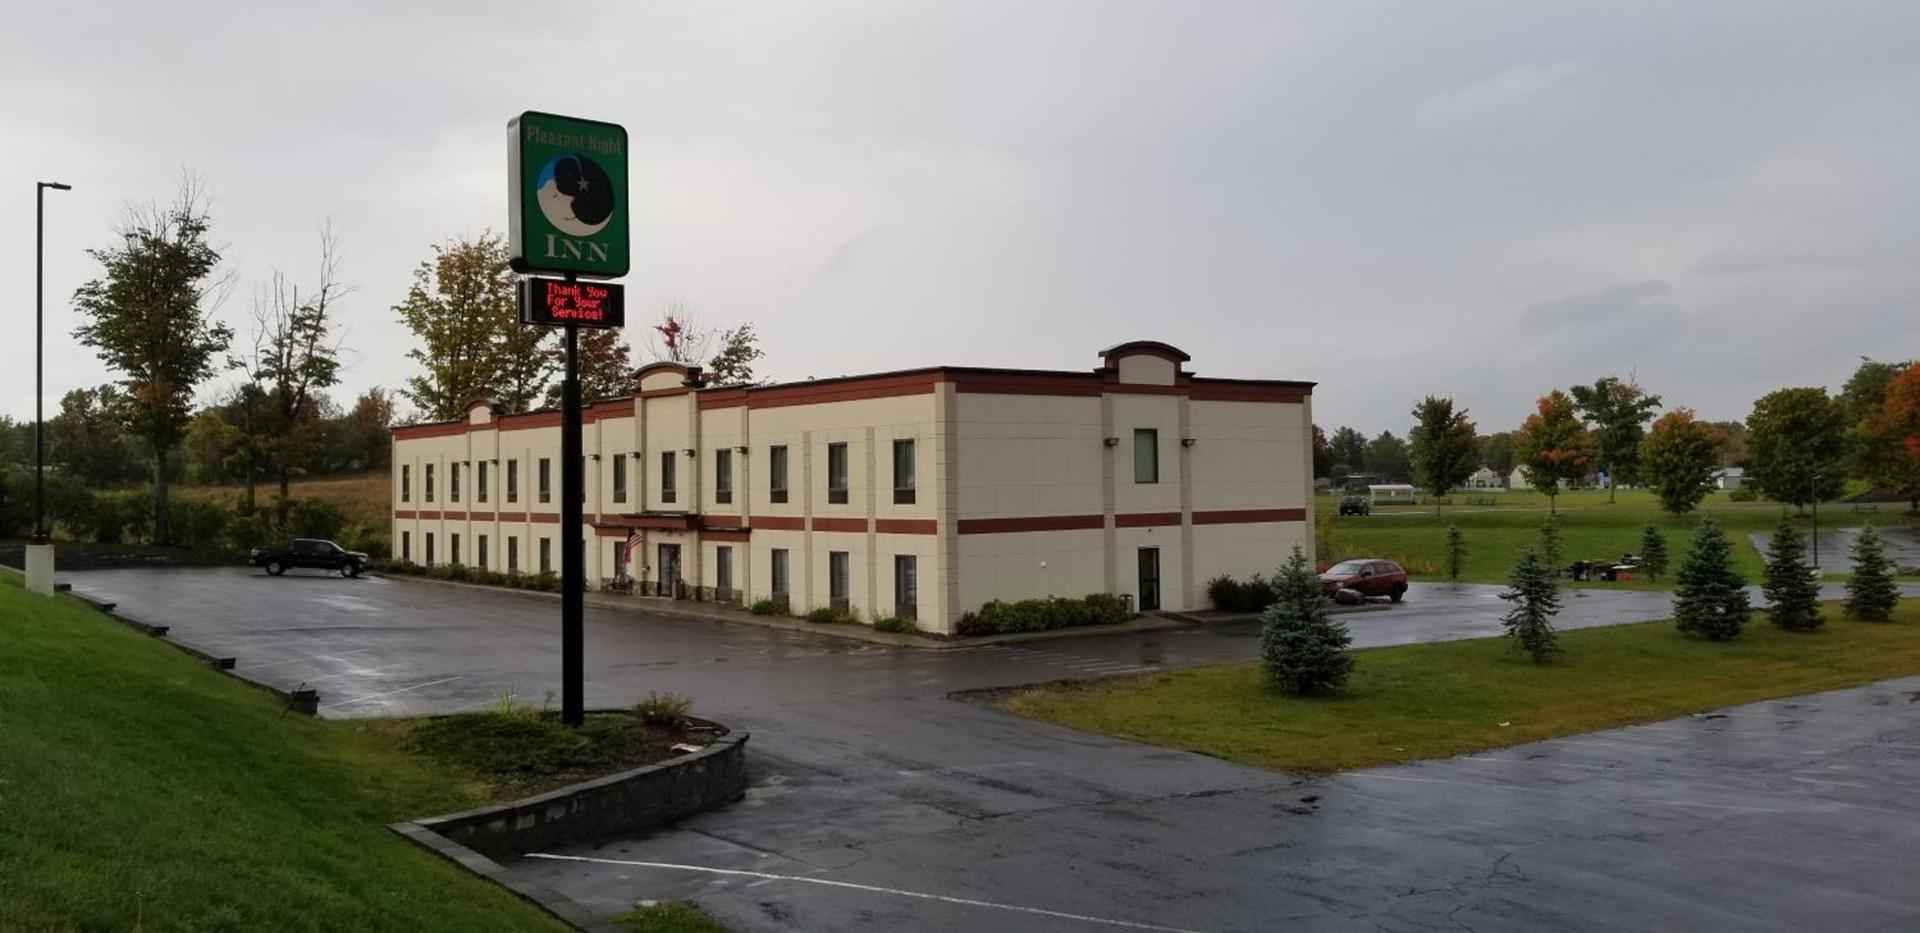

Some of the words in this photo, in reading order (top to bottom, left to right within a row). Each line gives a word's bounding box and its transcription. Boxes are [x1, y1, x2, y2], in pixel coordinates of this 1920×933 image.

[526, 125, 584, 149] Pleasant
[588, 133, 622, 155] Night
[544, 233, 609, 262] INN
[546, 283, 580, 296] Thank
[587, 286, 607, 298] You
[547, 294, 567, 306] For
[575, 297, 600, 308] Your
[552, 306, 602, 320] Service!
